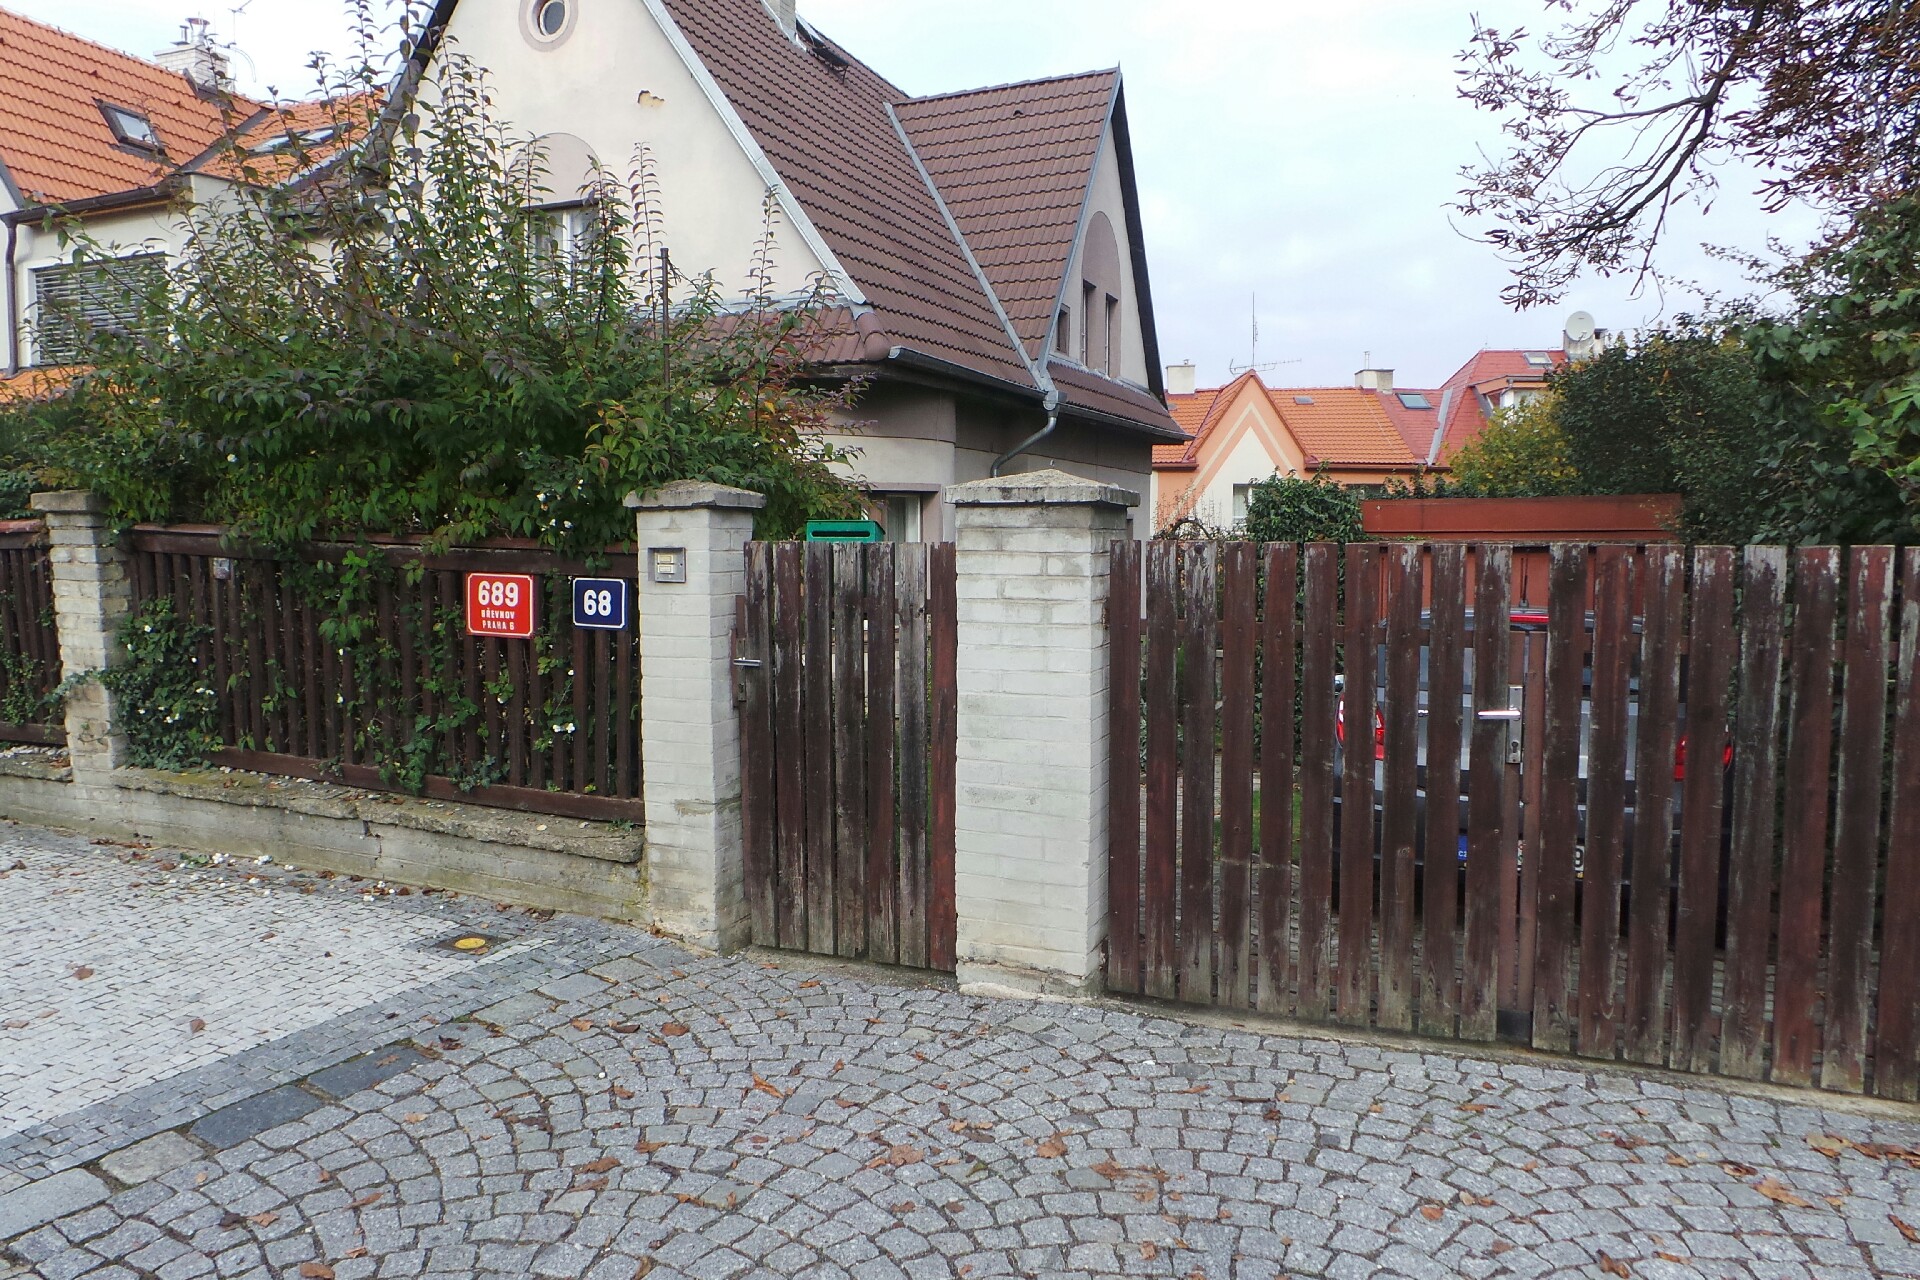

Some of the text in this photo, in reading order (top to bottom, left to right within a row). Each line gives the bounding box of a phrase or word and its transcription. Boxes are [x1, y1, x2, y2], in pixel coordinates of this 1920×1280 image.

[478, 581, 519, 607] 689
[583, 589, 612, 617] 68
[481, 608, 515, 620] BŘEVNOV
[482, 620, 515, 631] PRAHA 6
